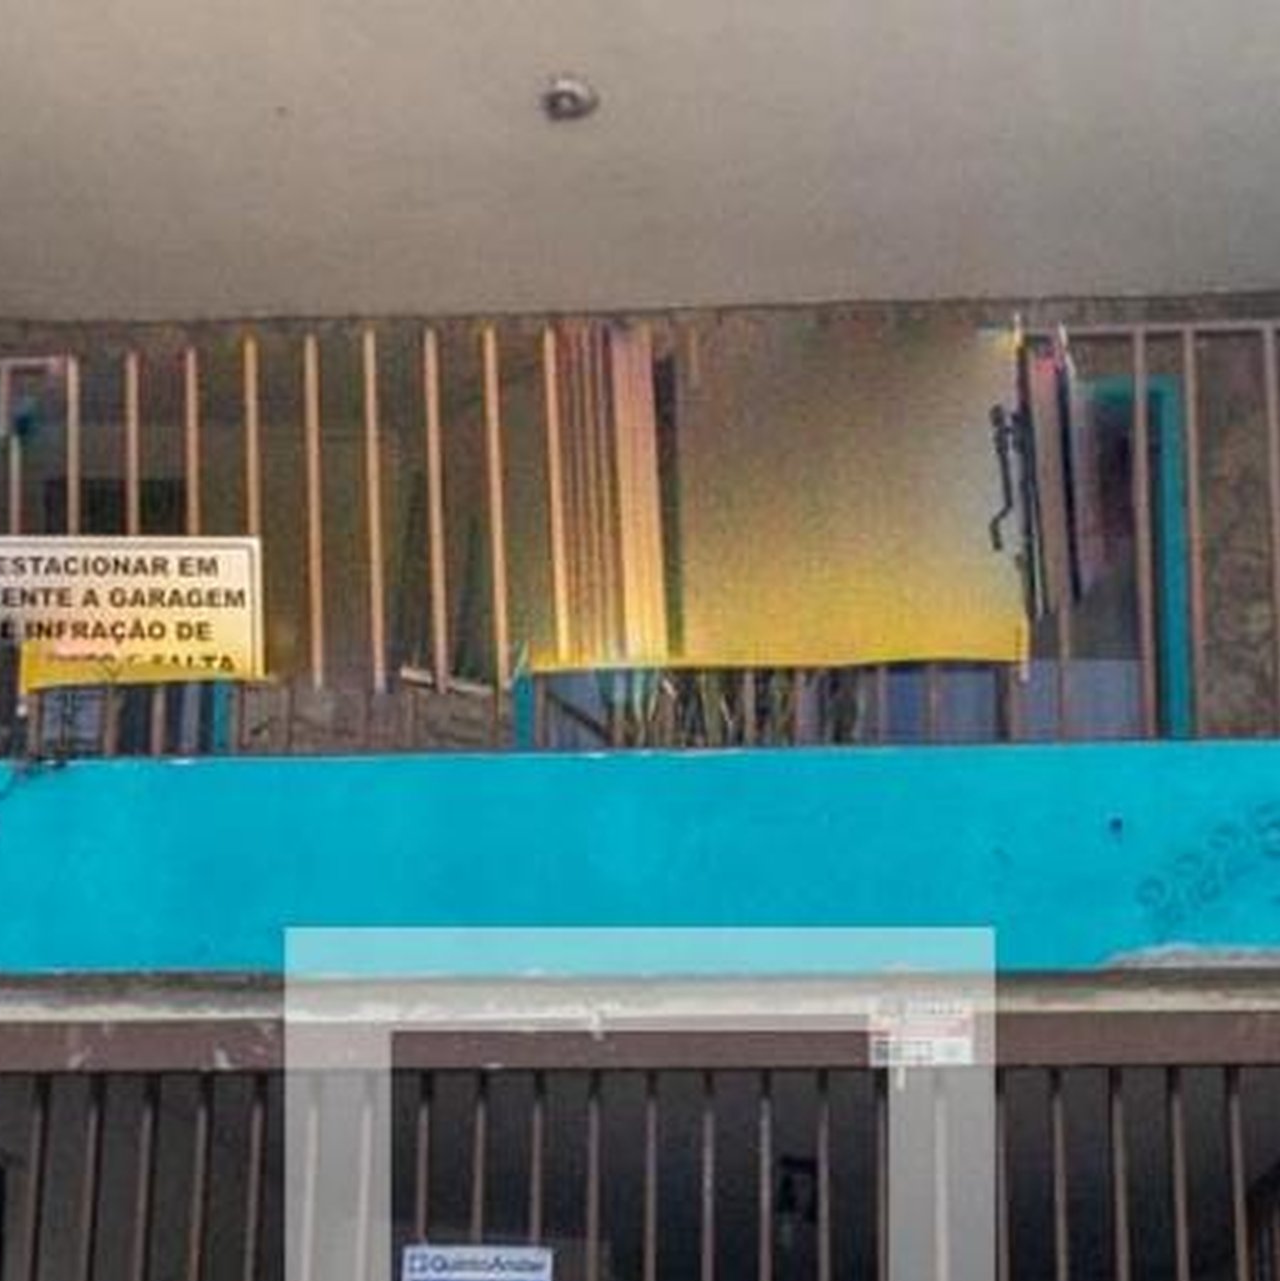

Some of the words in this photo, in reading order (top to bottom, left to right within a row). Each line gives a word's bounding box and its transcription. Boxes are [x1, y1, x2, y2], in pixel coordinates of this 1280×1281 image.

[179, 556, 218, 577] EM
[82, 587, 102, 608] A
[109, 586, 246, 608] GARAGEM
[25, 616, 166, 646] INFRAÇÃO
[176, 621, 214, 641] DE
